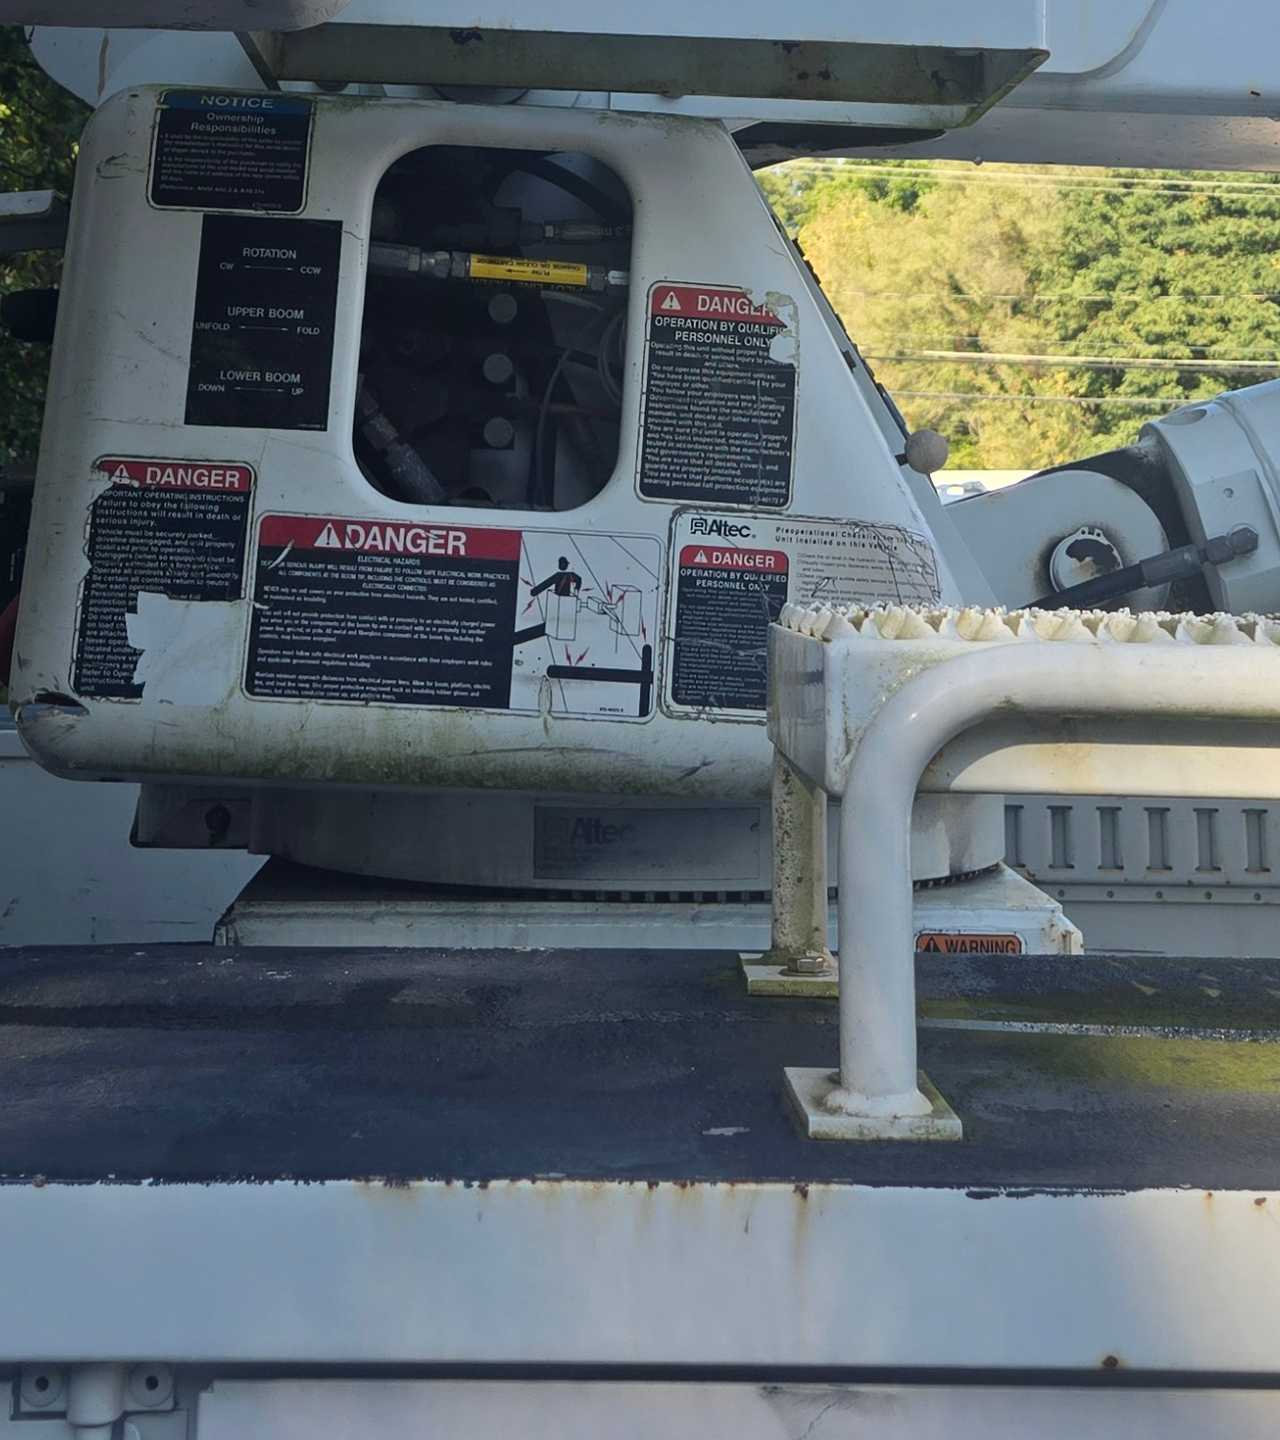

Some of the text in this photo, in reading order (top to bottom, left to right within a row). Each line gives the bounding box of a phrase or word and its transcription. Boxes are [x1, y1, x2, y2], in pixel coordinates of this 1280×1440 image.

[200, 95, 273, 109] NOTICE
[206, 112, 264, 124] Ownership
[190, 122, 276, 135] Responsibilities
[242, 247, 297, 259] ROTATION
[219, 262, 322, 274] CW CCW
[227, 307, 304, 320] UPPER BOOM
[195, 322, 320, 335] UNFOLD FOLD
[655, 316, 784, 335] OPERATION BY QUALIFI
[675, 331, 771, 348] PERSONNEL ONLY
[220, 370, 301, 383] LOWER BOOM
[198, 384, 304, 396] DOWN UP
[146, 466, 240, 488] DANGER
[102, 490, 245, 502] MPORTANT OPERATING INSTRUCTIONS
[97, 500, 219, 512] Failure to obey the following
[96, 508, 148, 517] instructions
[151, 510, 166, 518] will
[168, 511, 193, 519] result
[195, 512, 204, 520] in
[206, 512, 230, 520] death
[95, 517, 157, 527] serious injury.
[156, 530, 185, 538] securely
[707, 519, 751, 538] Altec
[776, 527, 838, 538] Preoperational
[344, 524, 467, 555] DANGER
[796, 538, 833, 546] installed
[850, 540, 865, 548] this
[357, 555, 420, 566] ELECTRICAL HAZARDS
[712, 552, 775, 568] DANGER
[680, 568, 727, 579] OPERATION
[730, 571, 741, 580] BY
[696, 579, 745, 590] PERSONNEL
[944, 939, 1016, 954] WARNING
